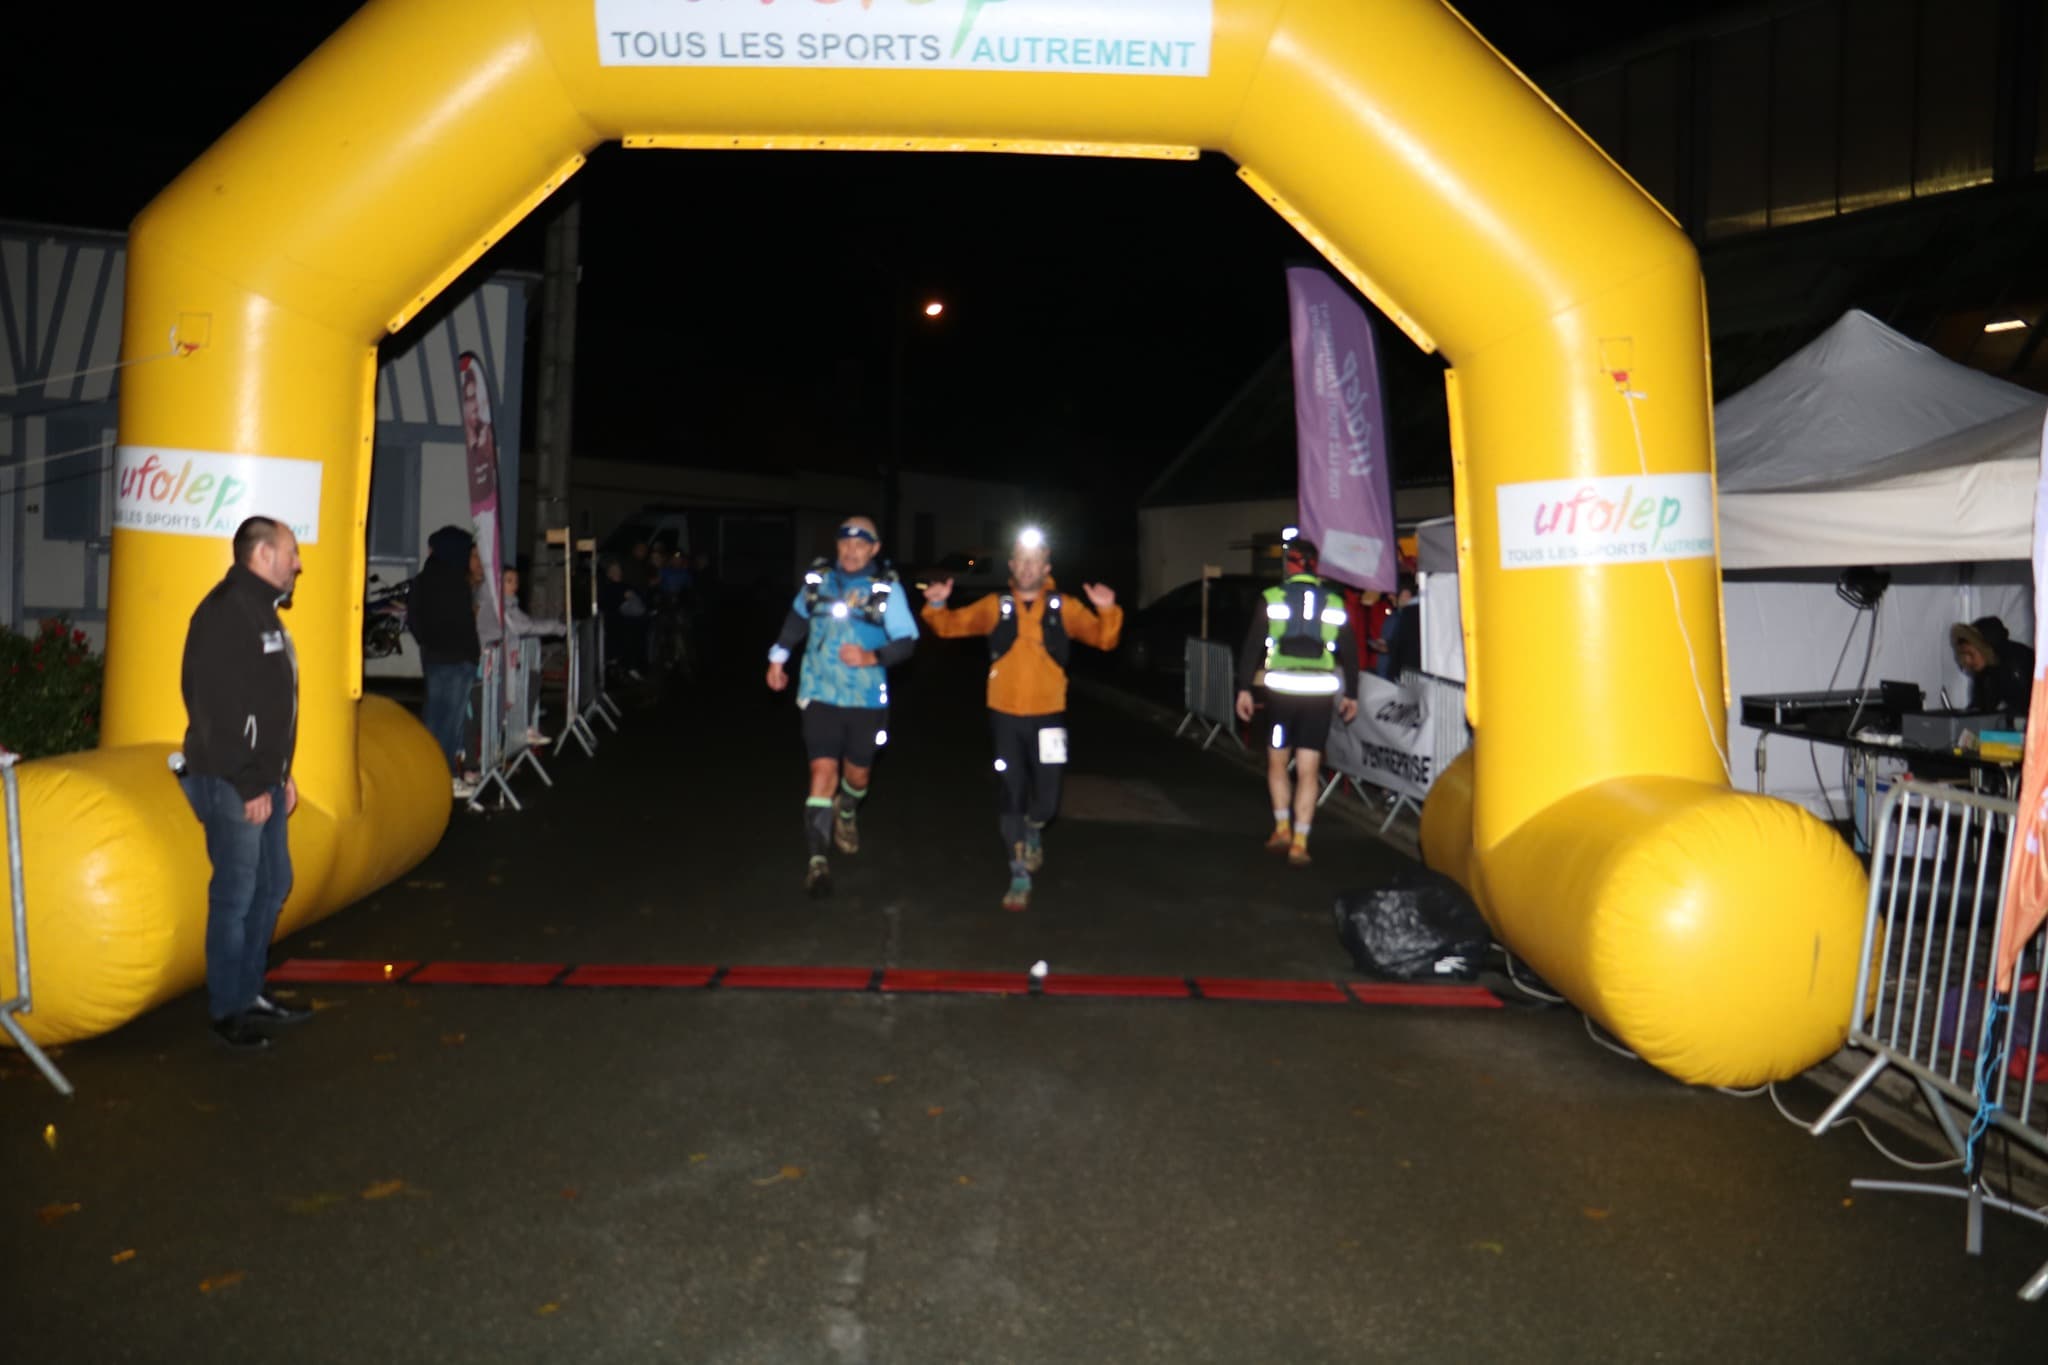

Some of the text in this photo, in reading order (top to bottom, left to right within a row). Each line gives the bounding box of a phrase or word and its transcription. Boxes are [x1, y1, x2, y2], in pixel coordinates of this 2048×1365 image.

[611, 31, 1196, 67] TOUS LES SPORTS AUTREMENT
[119, 454, 246, 528] ufolep
[143, 511, 201, 529] SPORTS
[1534, 484, 1681, 549] ufolep
[1507, 548, 1543, 561] TOUS
[1549, 545, 1577, 559] LES
[1582, 542, 1647, 557] ORTS
